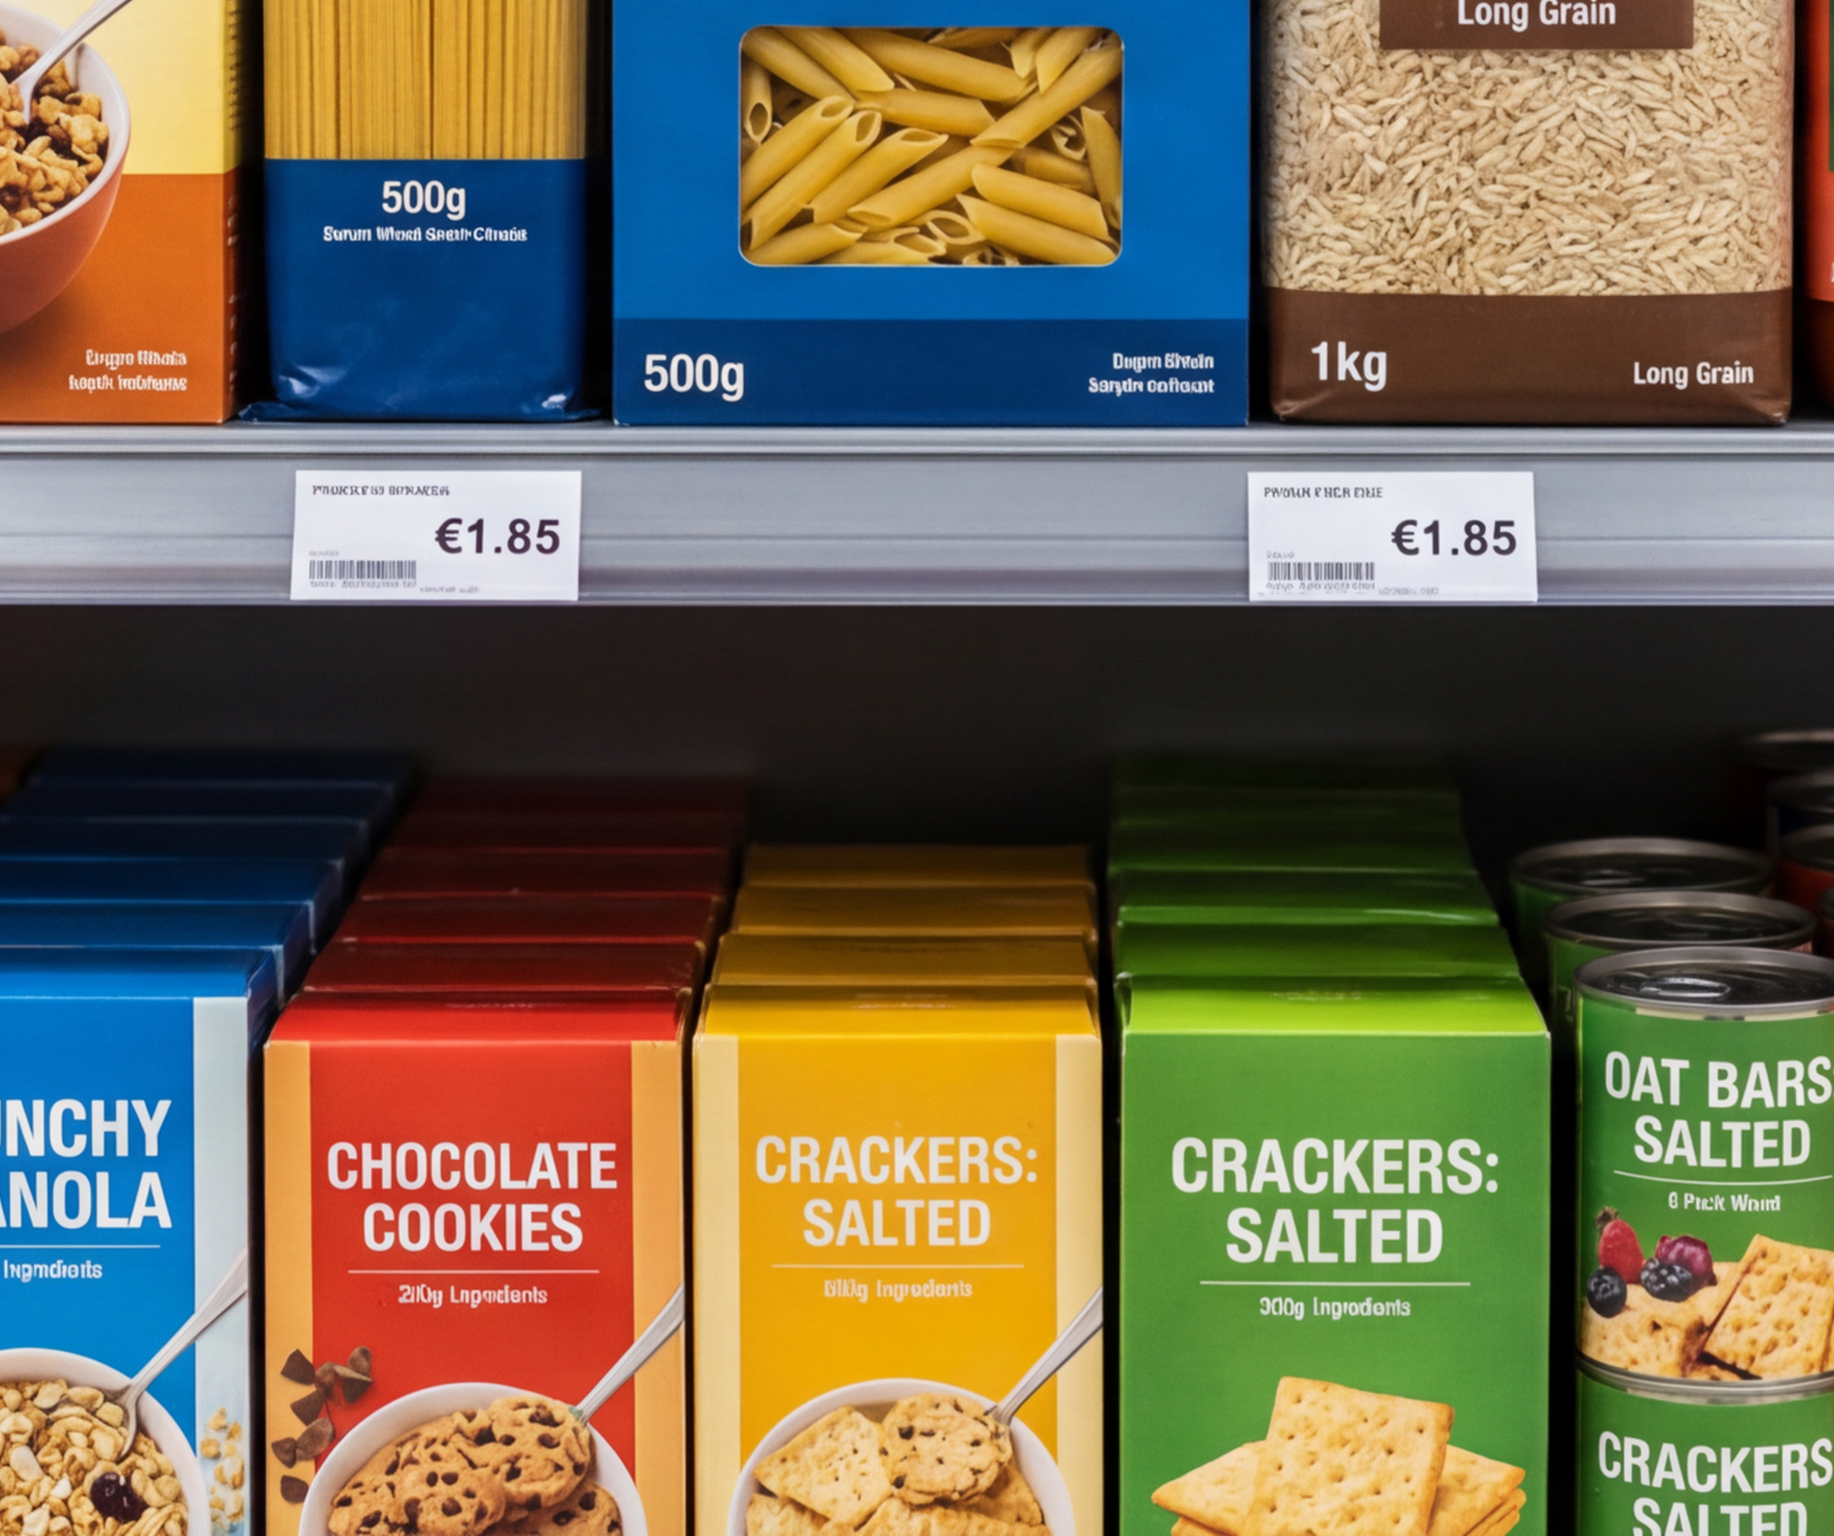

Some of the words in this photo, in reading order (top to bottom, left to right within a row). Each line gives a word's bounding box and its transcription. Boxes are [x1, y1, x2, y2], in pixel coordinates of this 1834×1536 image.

[381, 180, 466, 221] 500g
[644, 353, 745, 402] 500g
[1311, 341, 1387, 392] 1kg
[1633, 361, 1688, 390] Long
[1696, 360, 1754, 385] Grain
[435, 517, 560, 555] €1.85
[1391, 519, 1517, 556] €1.85
[1605, 1051, 1690, 1106] OAT
[327, 1142, 618, 1190] CHOCOLATE
[755, 1135, 1038, 1184] CRACKERS:
[1171, 1136, 1499, 1195] CRACKERS:
[1634, 1115, 1811, 1168] SALTED
[363, 1202, 583, 1252] COOKIES
[803, 1198, 991, 1247] SALTED
[1225, 1207, 1444, 1264] SALTED
[1631, 1498, 1808, 1536] SALTED
